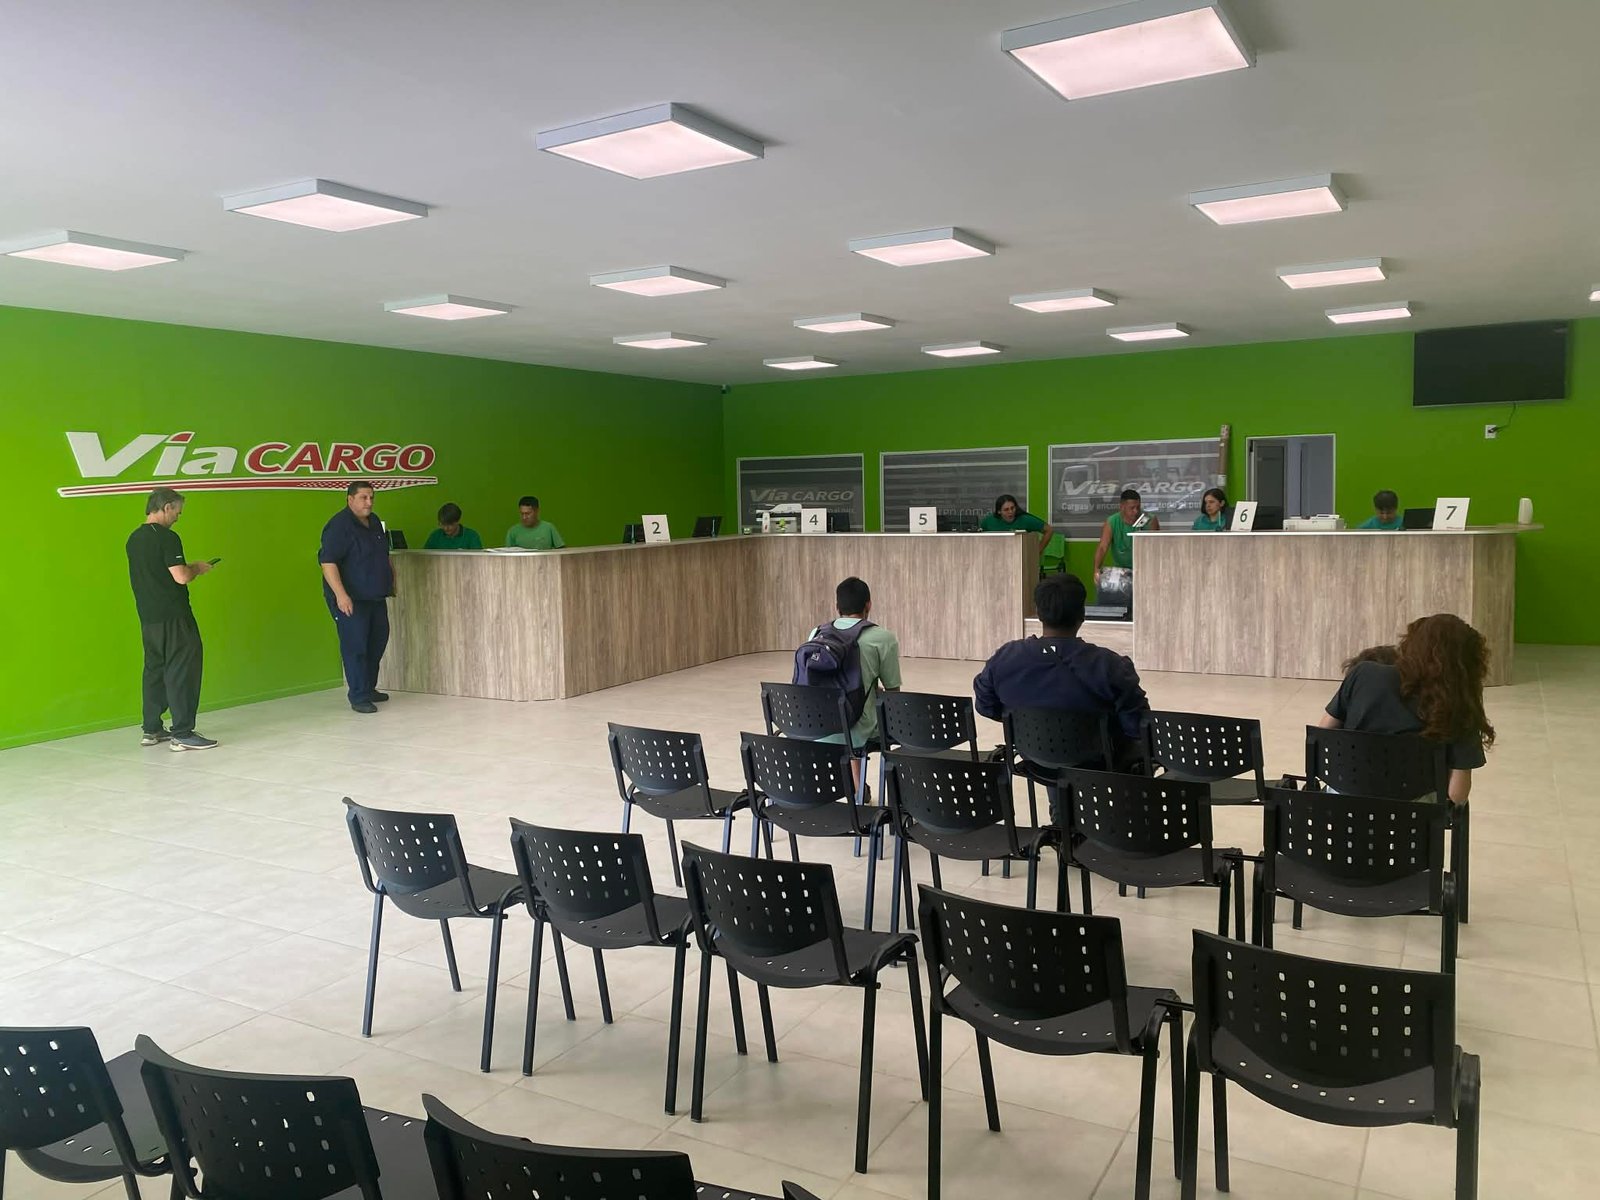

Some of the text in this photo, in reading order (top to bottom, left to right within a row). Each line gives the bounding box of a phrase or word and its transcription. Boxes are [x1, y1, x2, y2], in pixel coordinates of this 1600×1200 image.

[65, 431, 436, 479] Via CARGO
[1064, 480, 1206, 495] Via CARGO
[750, 489, 855, 502] Via CARGO
[809, 514, 819, 526] 4
[918, 513, 928, 526] 5
[1240, 509, 1249, 523] 6
[1446, 505, 1458, 521] 7
[651, 521, 662, 535] 2
